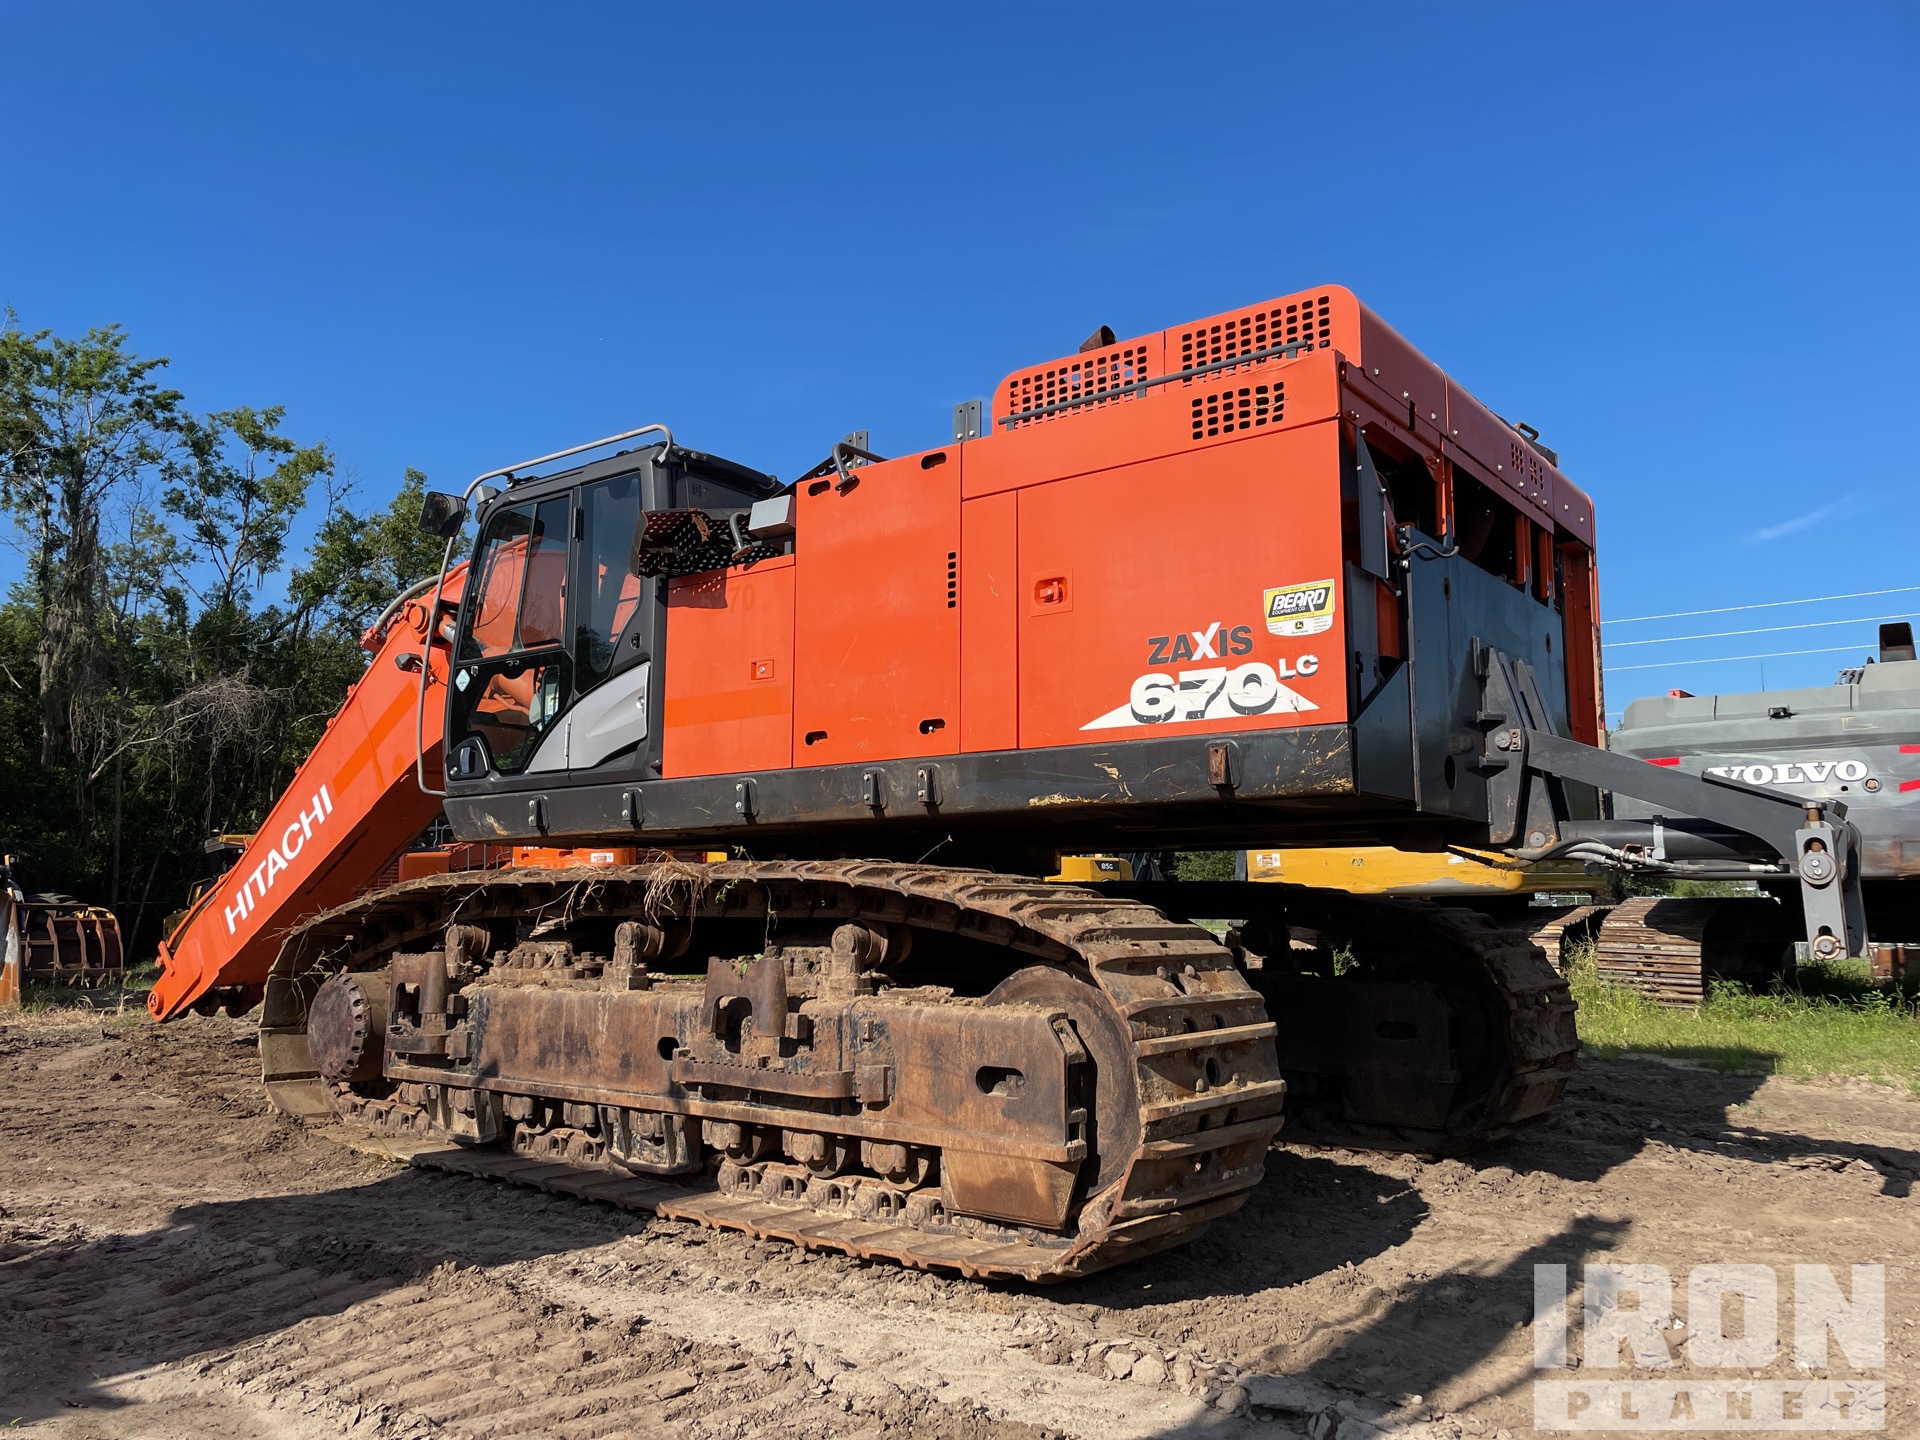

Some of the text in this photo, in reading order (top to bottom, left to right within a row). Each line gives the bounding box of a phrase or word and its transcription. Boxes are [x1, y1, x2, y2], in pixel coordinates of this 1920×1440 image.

[1271, 607, 1298, 616] EQUIPMENT
[1272, 588, 1326, 612] BEARD
[1148, 621, 1254, 665] ZAXIS
[1130, 653, 1319, 724] 670 LC
[1706, 760, 1868, 785] VOLVO
[224, 783, 333, 935] HITACHI
